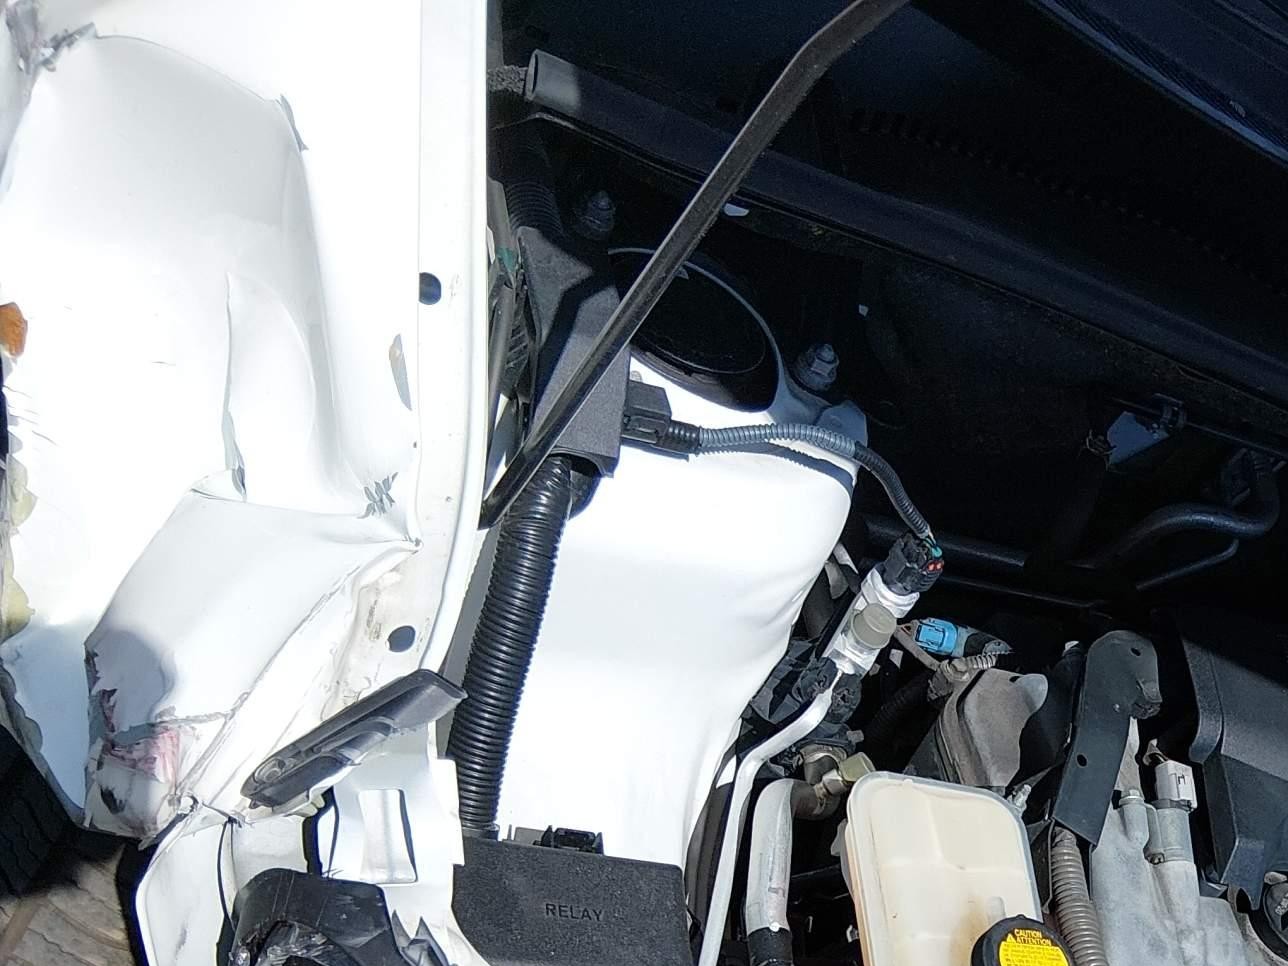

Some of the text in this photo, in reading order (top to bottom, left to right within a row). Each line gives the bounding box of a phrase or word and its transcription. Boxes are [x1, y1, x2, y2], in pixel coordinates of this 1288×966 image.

[545, 903, 603, 922] RELAY
[1014, 929, 1042, 939] CAUTION
[1016, 936, 1052, 947] ATTENTION
